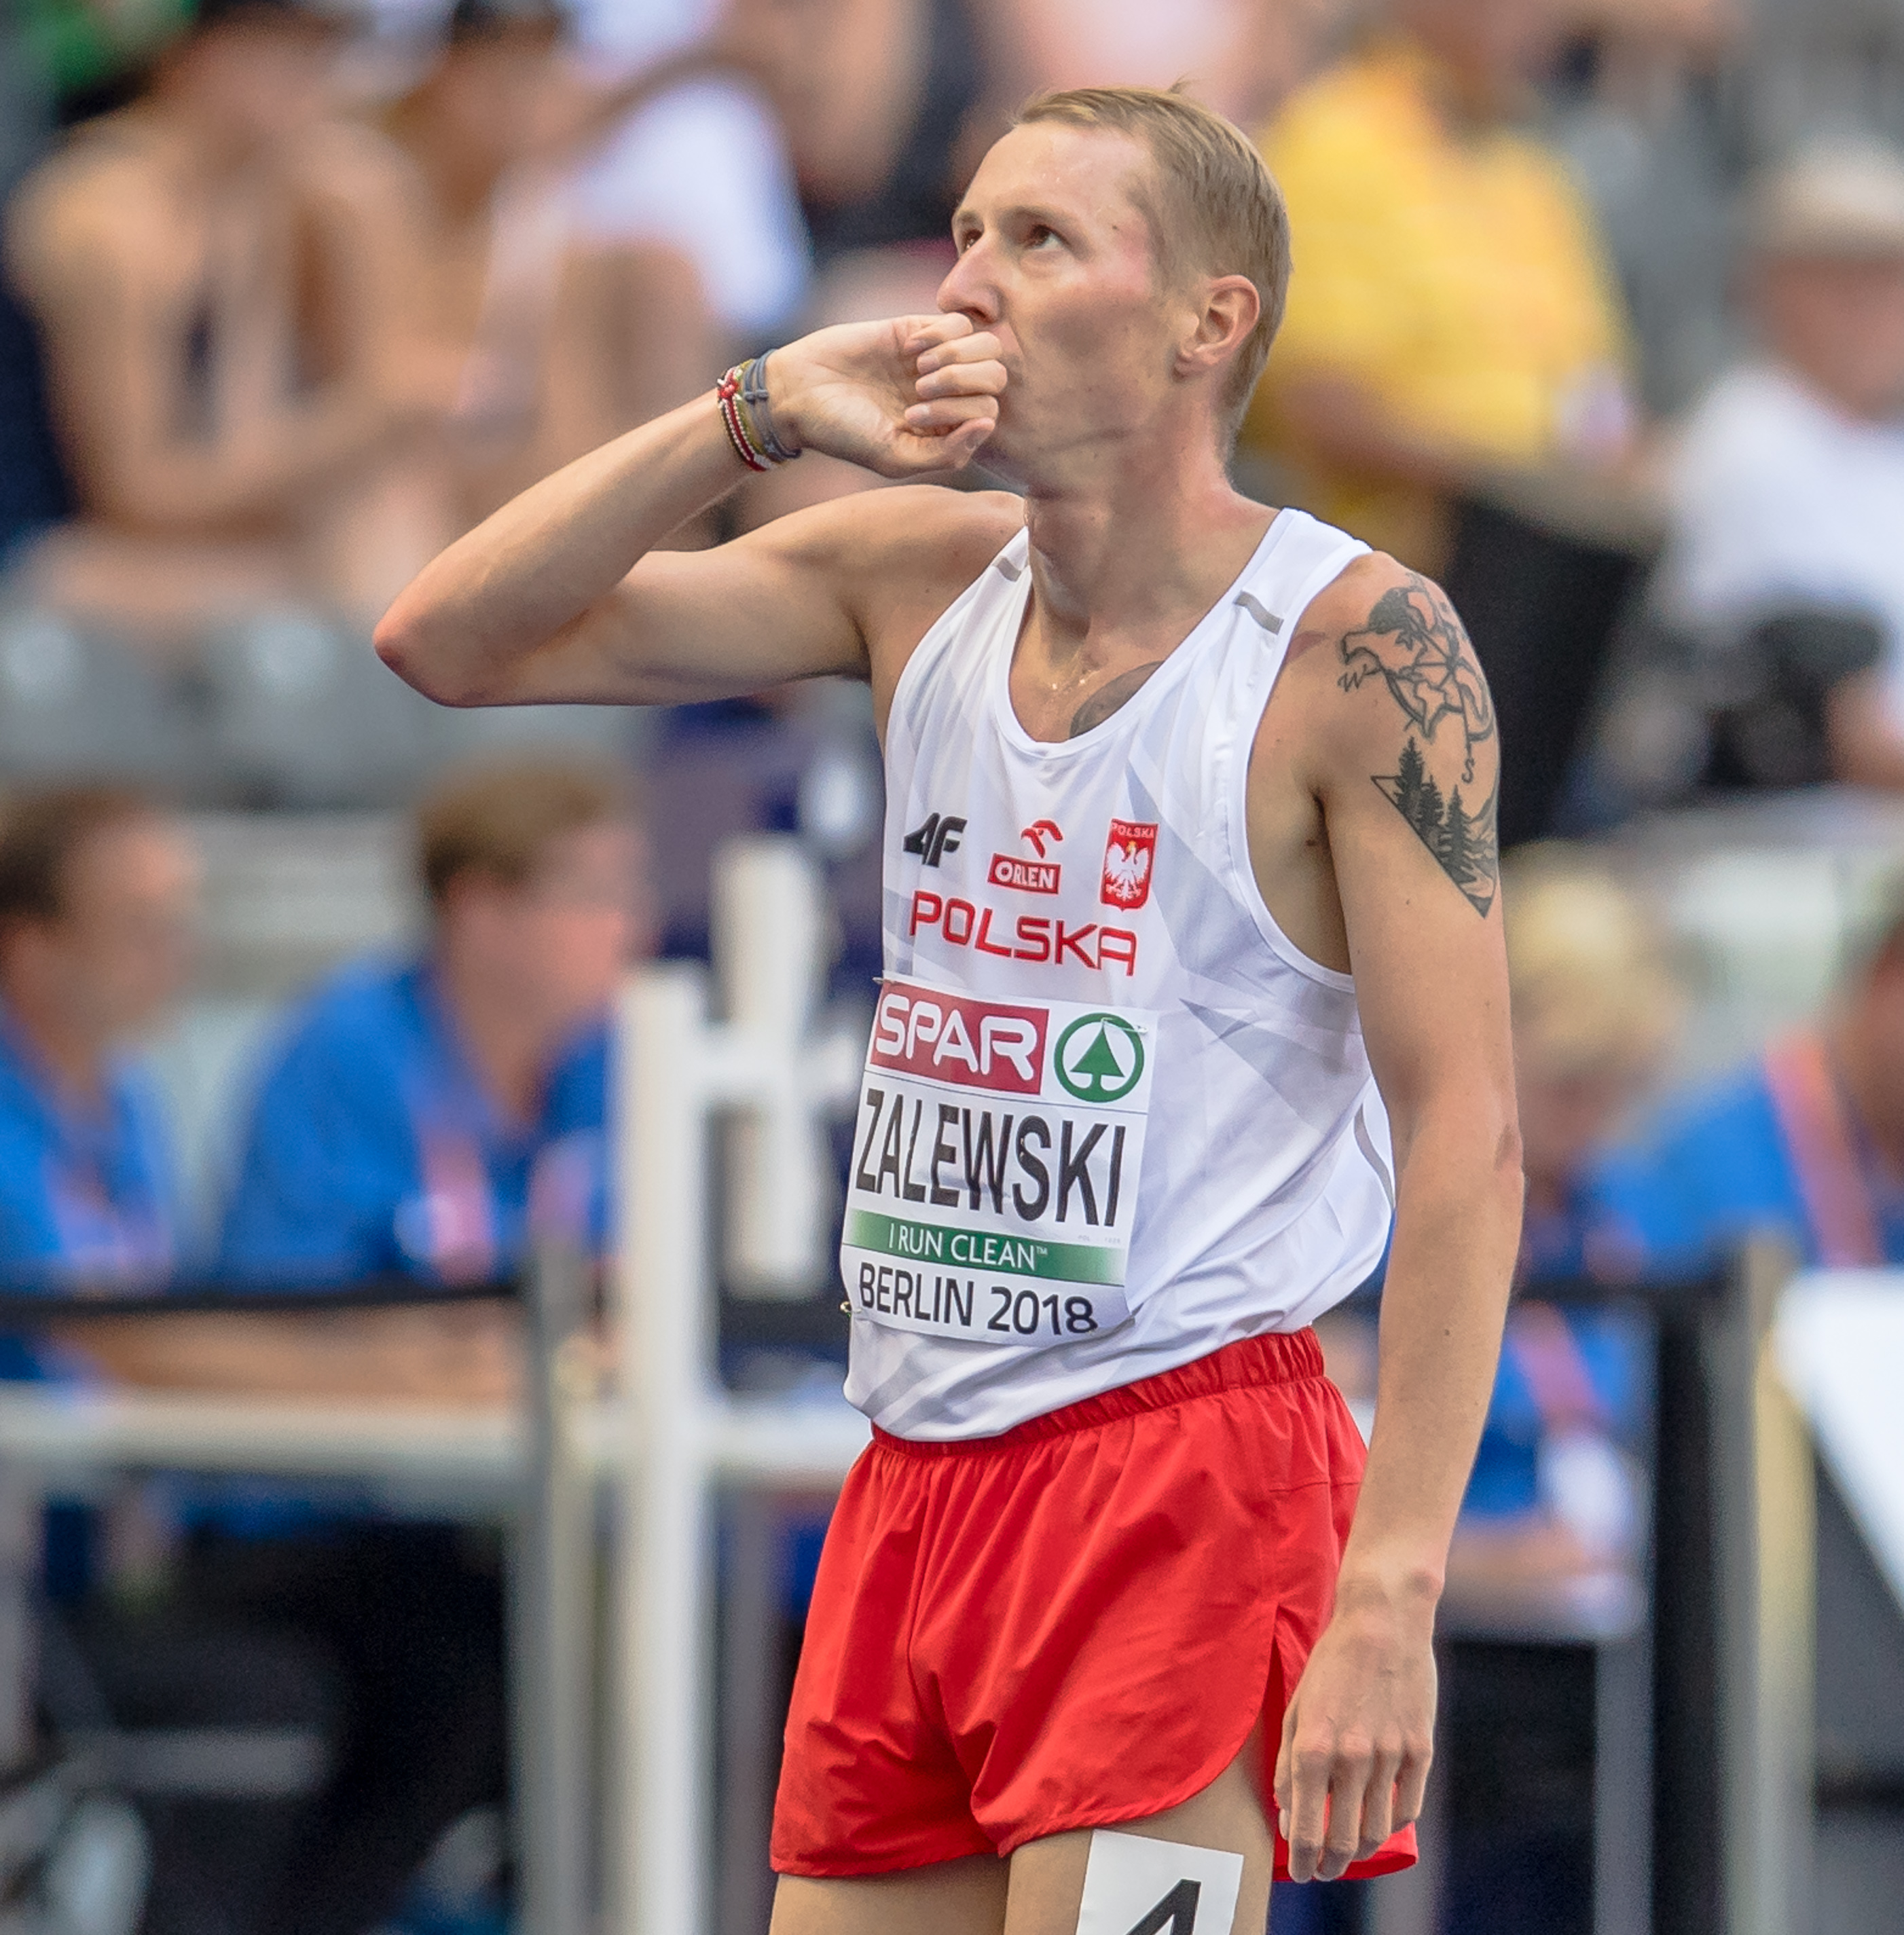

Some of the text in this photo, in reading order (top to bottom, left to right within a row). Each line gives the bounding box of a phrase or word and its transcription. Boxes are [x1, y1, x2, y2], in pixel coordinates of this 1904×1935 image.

[903, 813, 968, 868] 4F
[1111, 822, 1154, 838] POLSKA
[995, 861, 1056, 889] ORLEN
[909, 891, 1137, 976] POLSKA
[876, 993, 1038, 1081] SPAR
[855, 1088, 1127, 1227] ZALEWSKI
[888, 1223, 895, 1249] I
[898, 1229, 942, 1257] RUN
[860, 1261, 1099, 1335] BERLIN 2018
